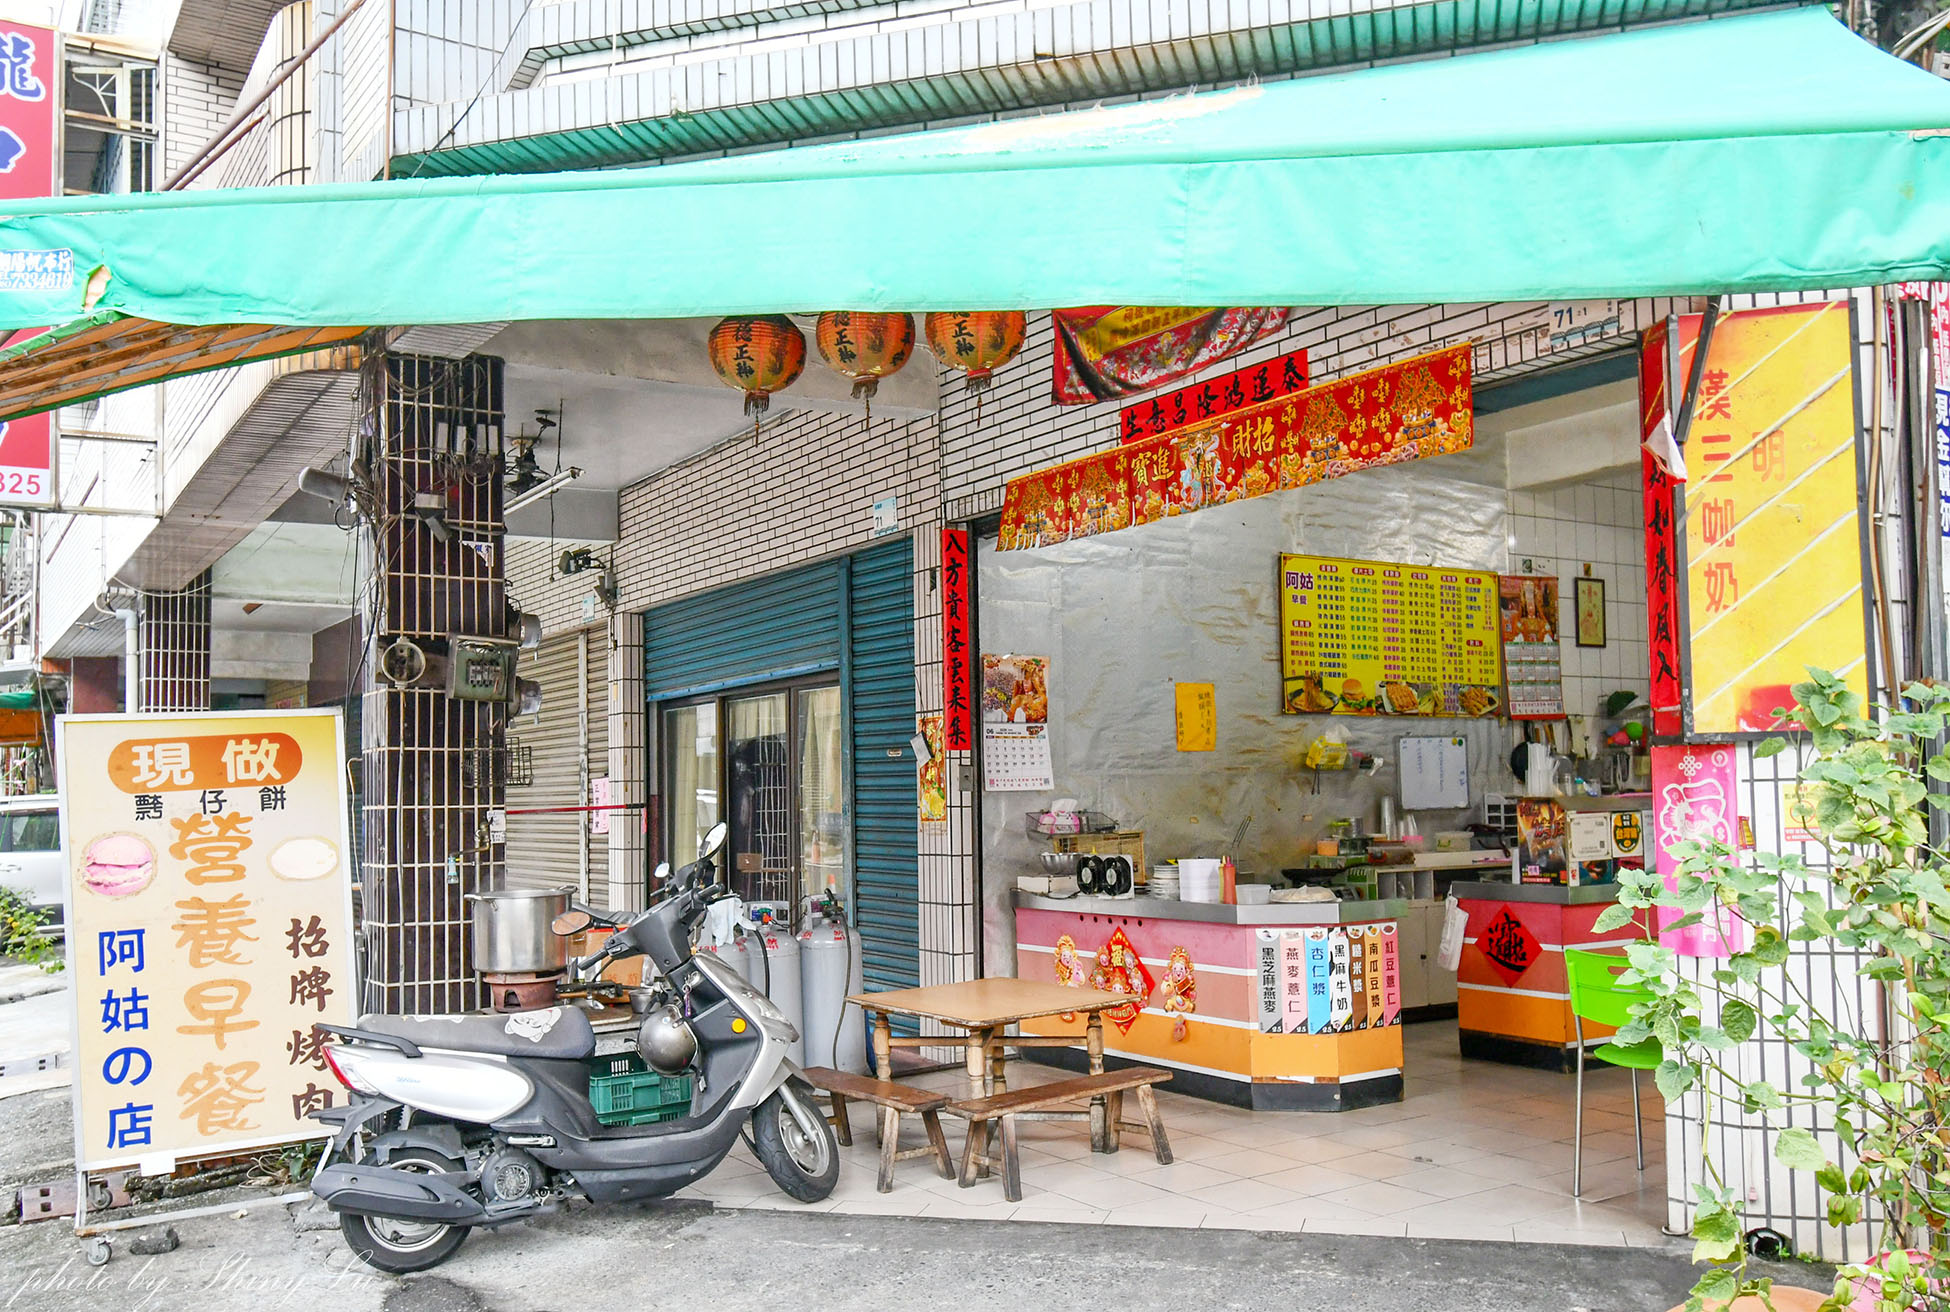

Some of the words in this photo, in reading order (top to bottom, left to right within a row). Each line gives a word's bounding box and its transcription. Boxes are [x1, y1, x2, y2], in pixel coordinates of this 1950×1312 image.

[1286, 571, 1314, 590] 阿姑
[132, 738, 282, 788] 現做
[168, 811, 267, 1138] 營養早餐
[1262, 947, 1277, 1014] 黑芝麻燕麥
[1286, 947, 1301, 1013] 燕麥薏仁
[1334, 944, 1348, 1011] 黑麻牛奶
[1385, 940, 1397, 1006] 紅豆薏仁
[98, 928, 154, 1149] 阿姑の店
[285, 915, 335, 1121] 招牌烤肉
